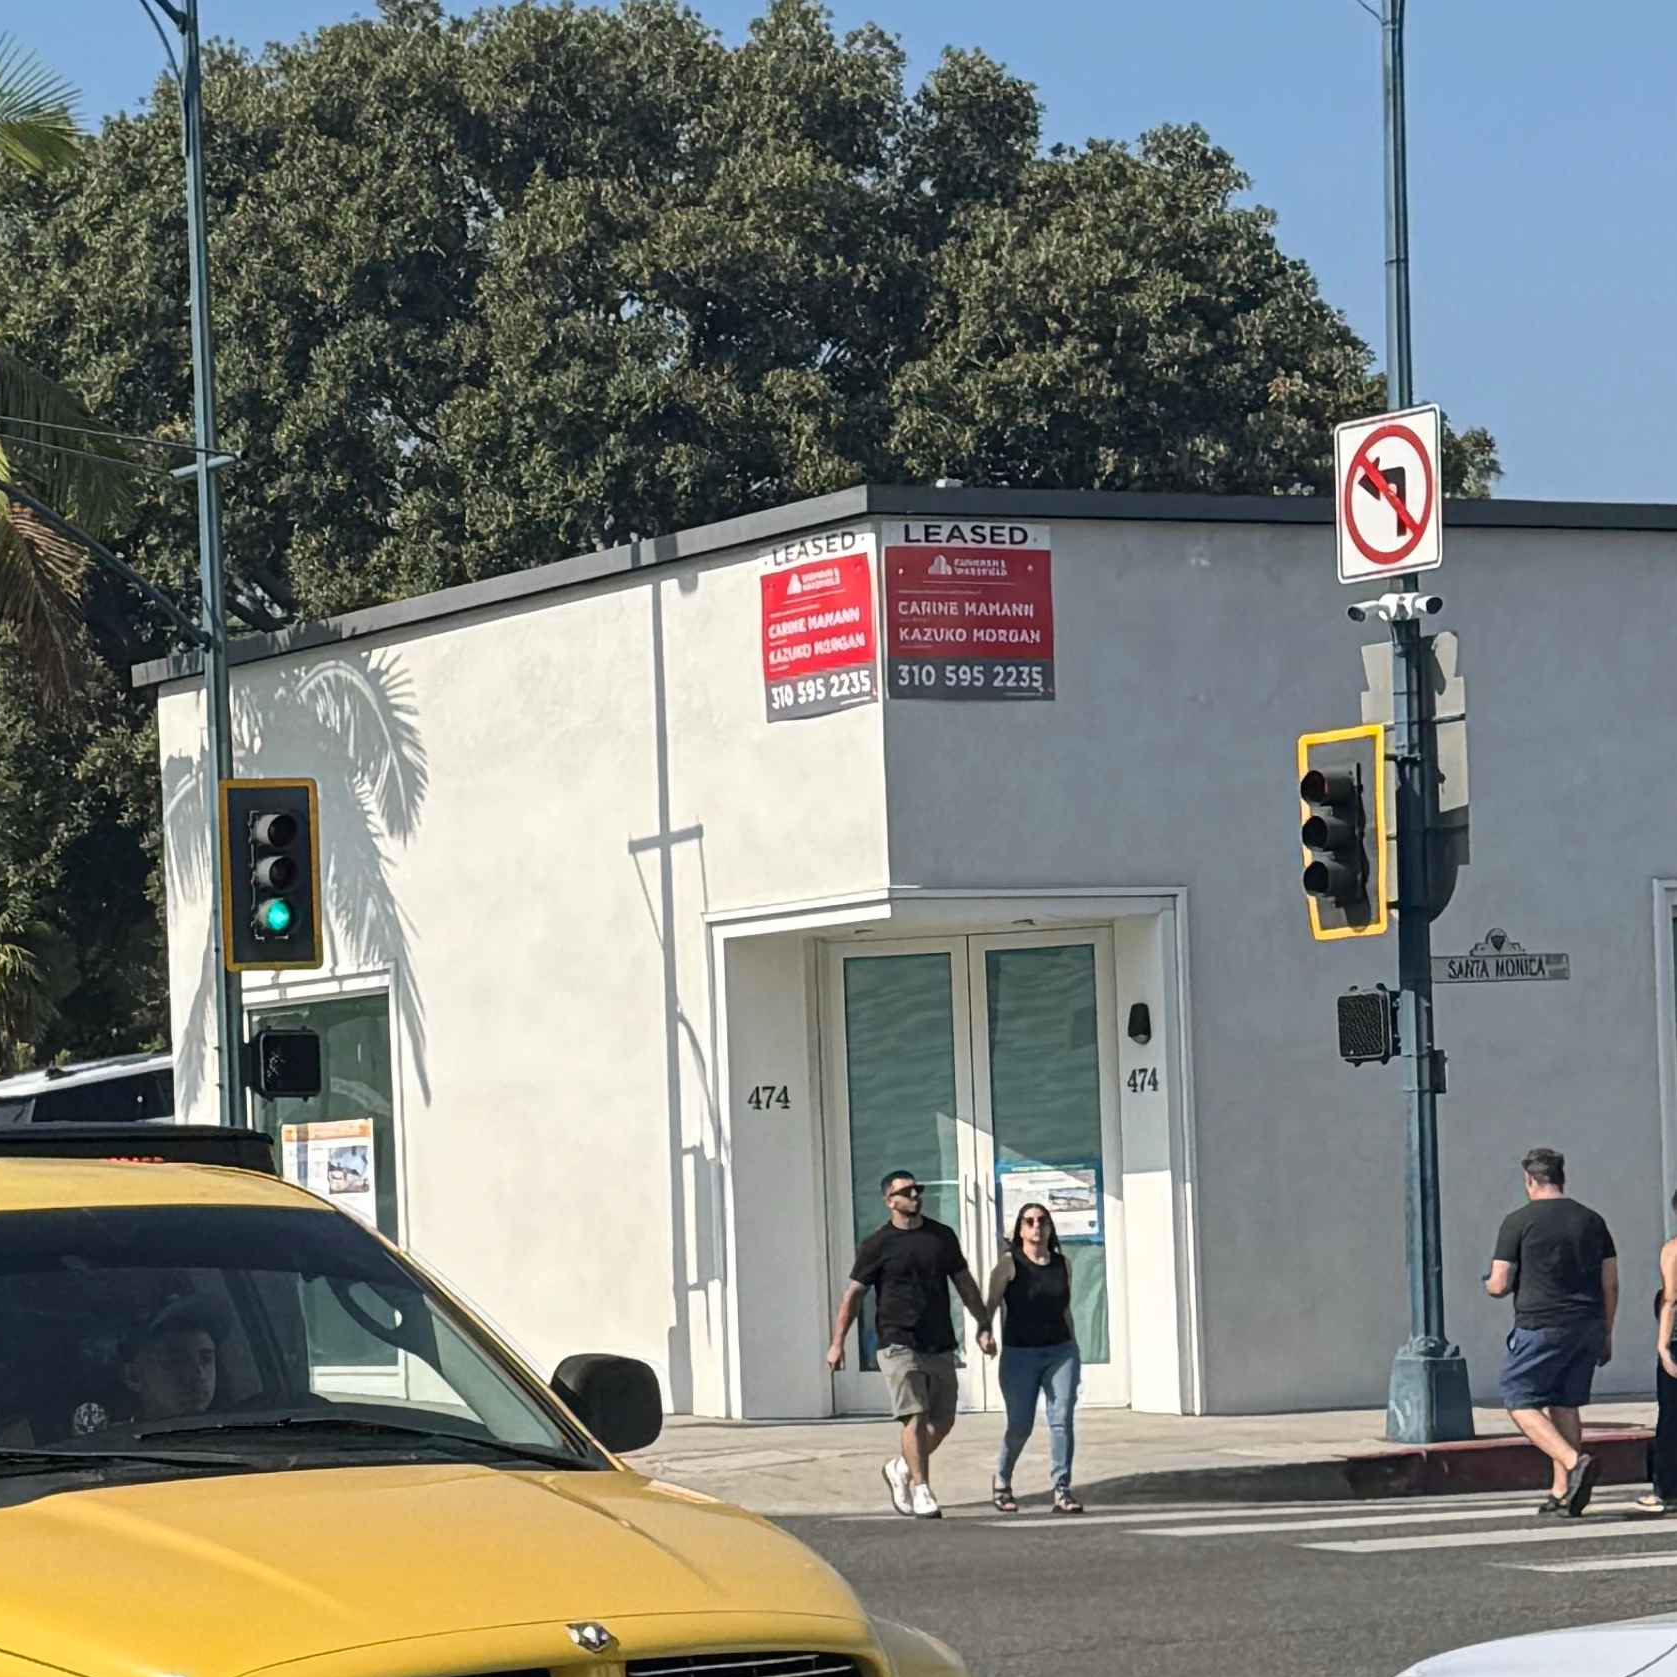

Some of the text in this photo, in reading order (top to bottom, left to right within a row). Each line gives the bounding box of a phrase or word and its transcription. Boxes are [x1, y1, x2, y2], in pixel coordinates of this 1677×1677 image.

[904, 524, 1029, 546] LEASED
[773, 531, 856, 567] LEASED
[897, 601, 959, 616] CARINE
[898, 627, 1041, 644] KAZUKO MORGAN
[898, 664, 1043, 688] 310 595 2235
[771, 670, 872, 710] 310 595 2235
[1448, 959, 1489, 979] SANTA
[1495, 957, 1545, 978] MONICA
[1127, 1066, 1159, 1093] 474
[747, 1085, 791, 1110] 474
